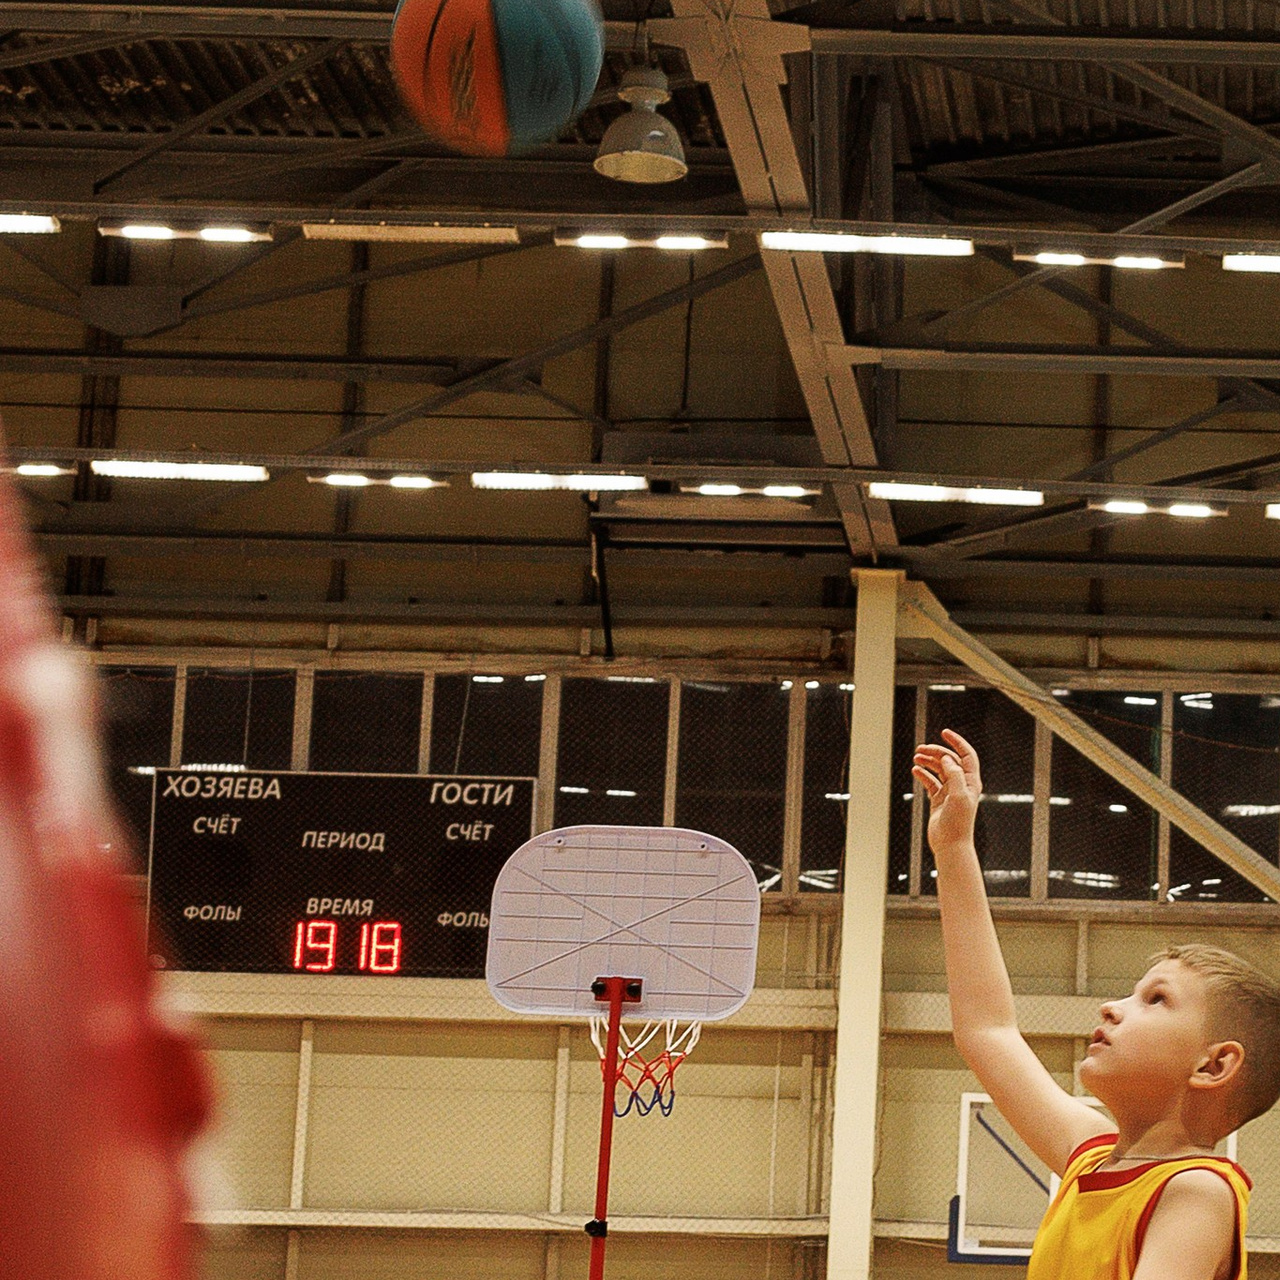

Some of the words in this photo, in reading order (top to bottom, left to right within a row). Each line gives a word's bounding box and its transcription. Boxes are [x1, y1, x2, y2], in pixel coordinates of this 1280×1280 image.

[162, 775, 282, 800] ХОЗЯЕВА
[429, 782, 515, 806] ГОСТИ
[192, 813, 242, 835] СЧЁТ
[445, 820, 495, 841] СЧЁТ
[301, 830, 386, 853] ПЕРИОД
[183, 904, 242, 921] ФОЛЫ
[305, 897, 375, 917] ВРЕМЯ
